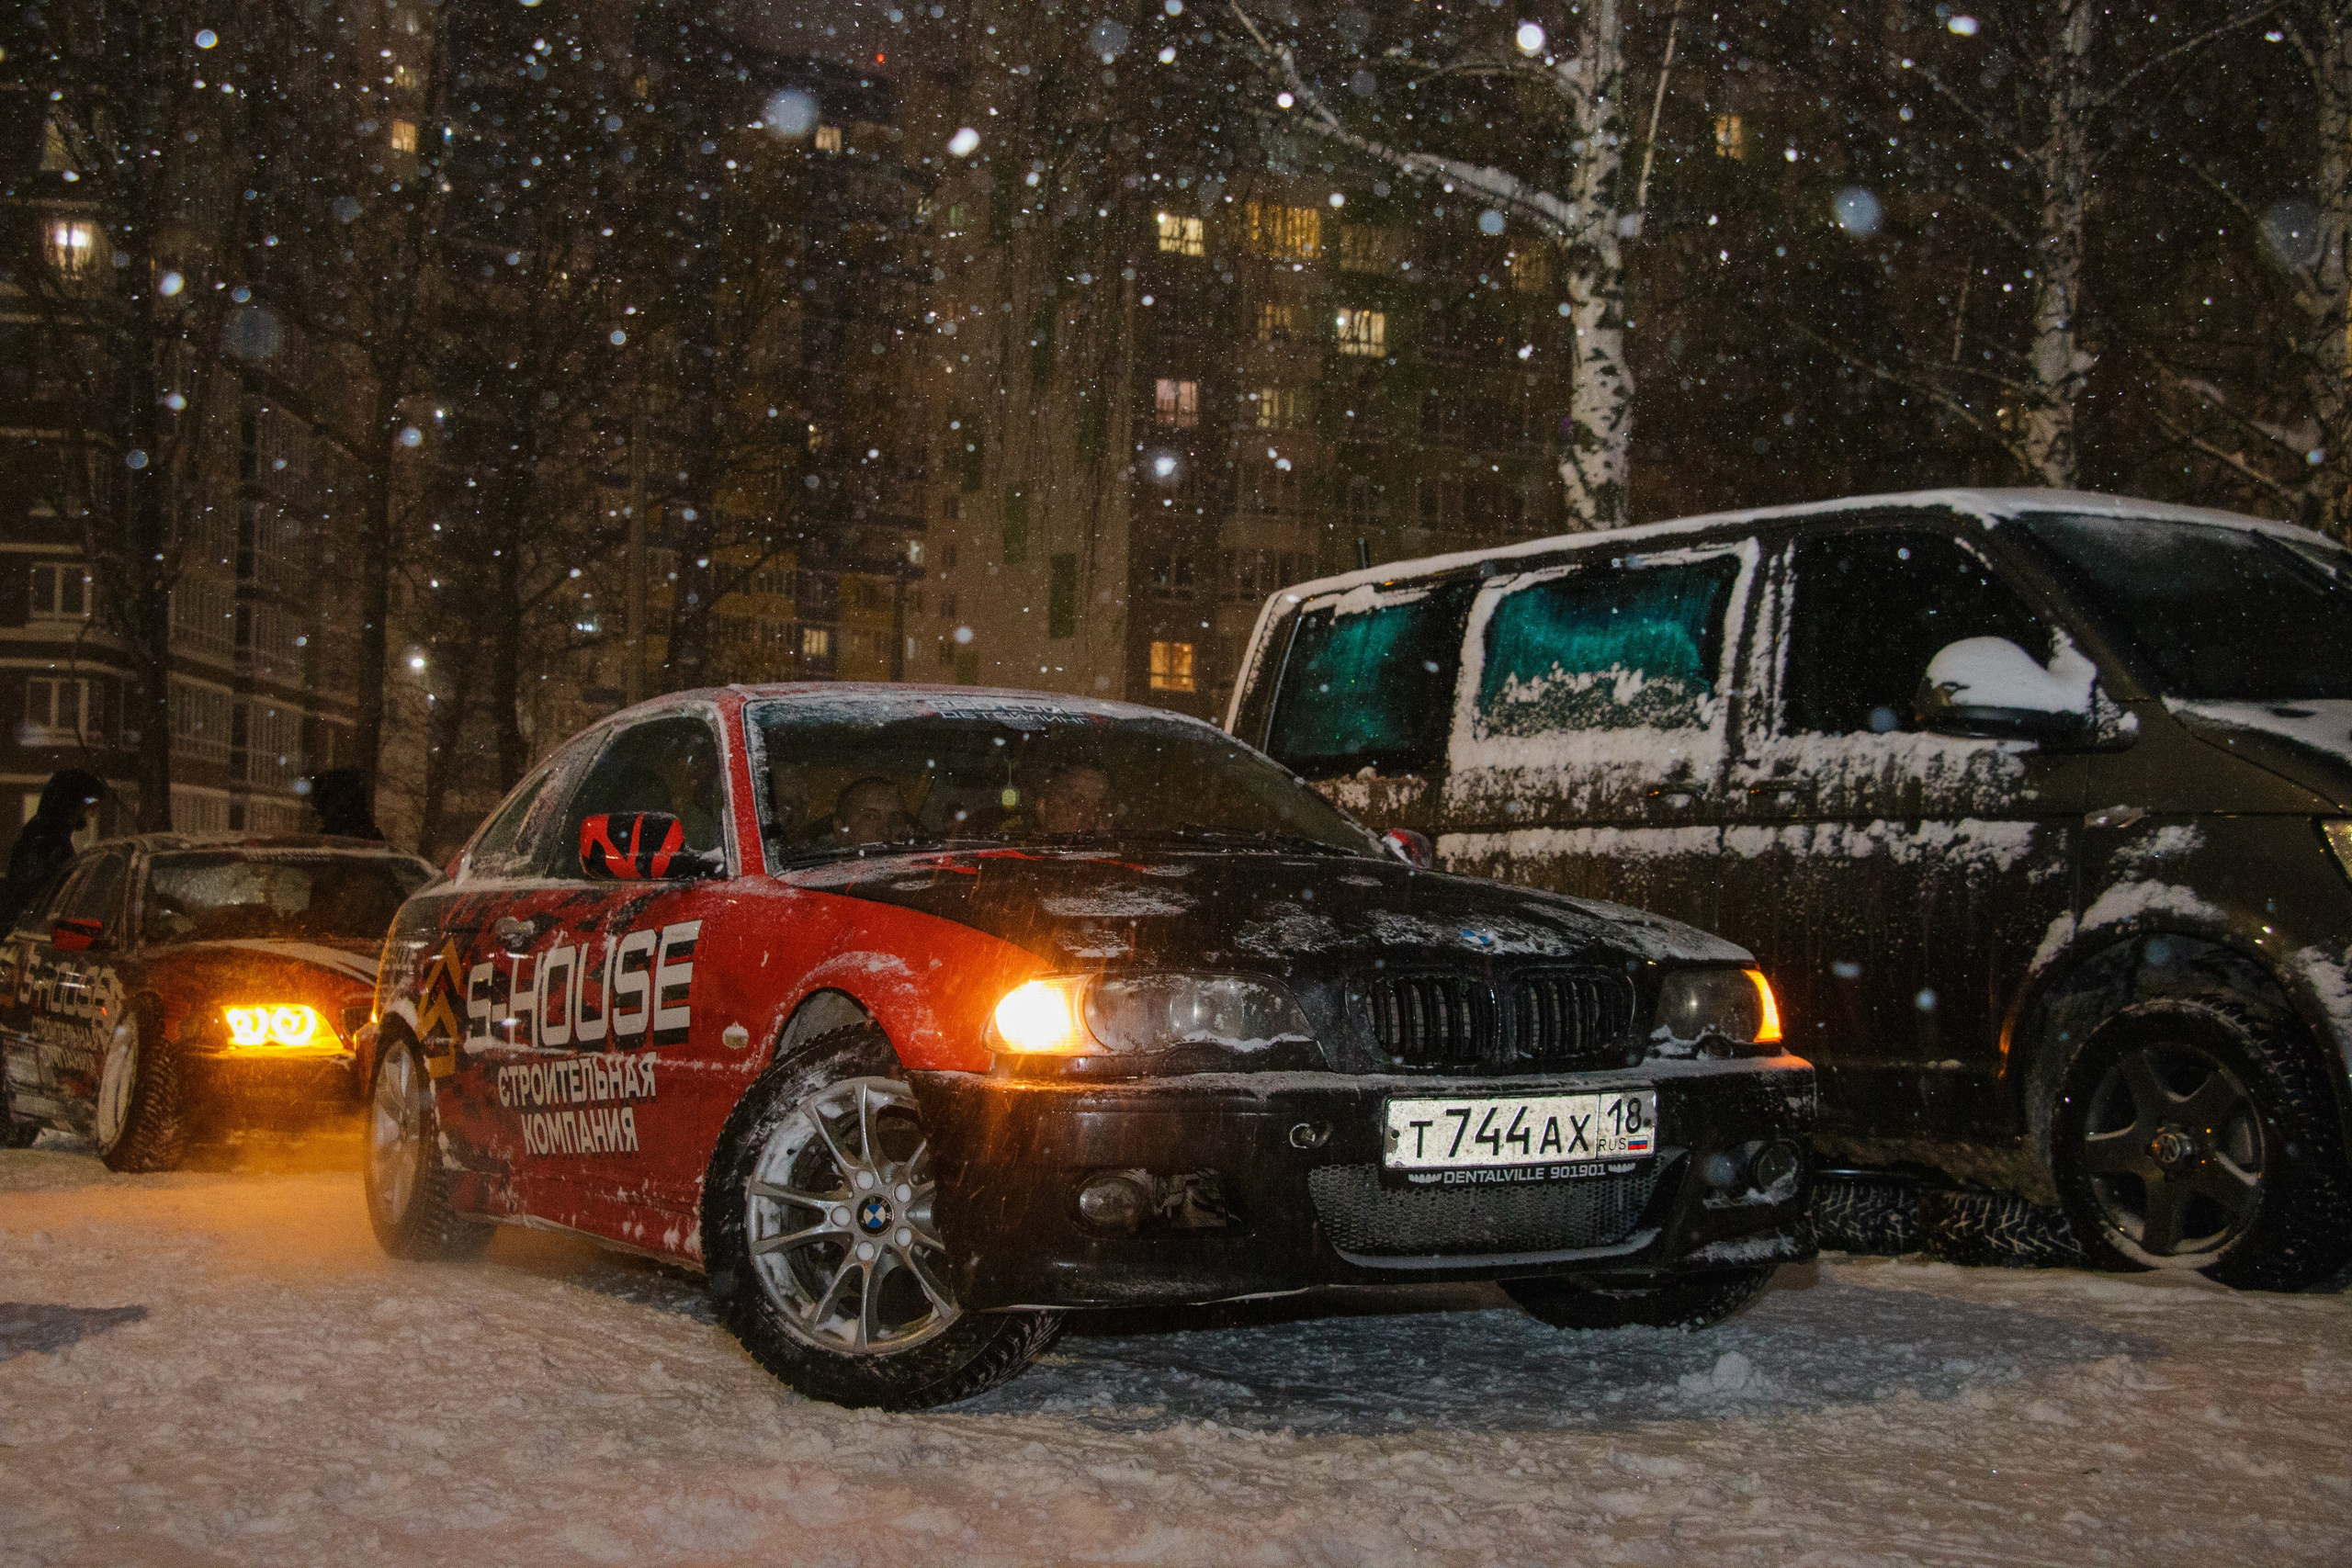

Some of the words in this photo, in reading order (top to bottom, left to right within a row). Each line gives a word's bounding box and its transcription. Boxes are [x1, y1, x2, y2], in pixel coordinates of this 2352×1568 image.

[498, 1052, 657, 1107] СТРОИТЕЛЬНАЯ
[521, 1107, 639, 1155] КОМПАНИЯ
[1608, 1098, 1642, 1135] 18
[1598, 1137, 1626, 1151] RUS
[1443, 1168, 1544, 1184] DENTALVILLE
[1550, 1164, 1606, 1179] 901901
